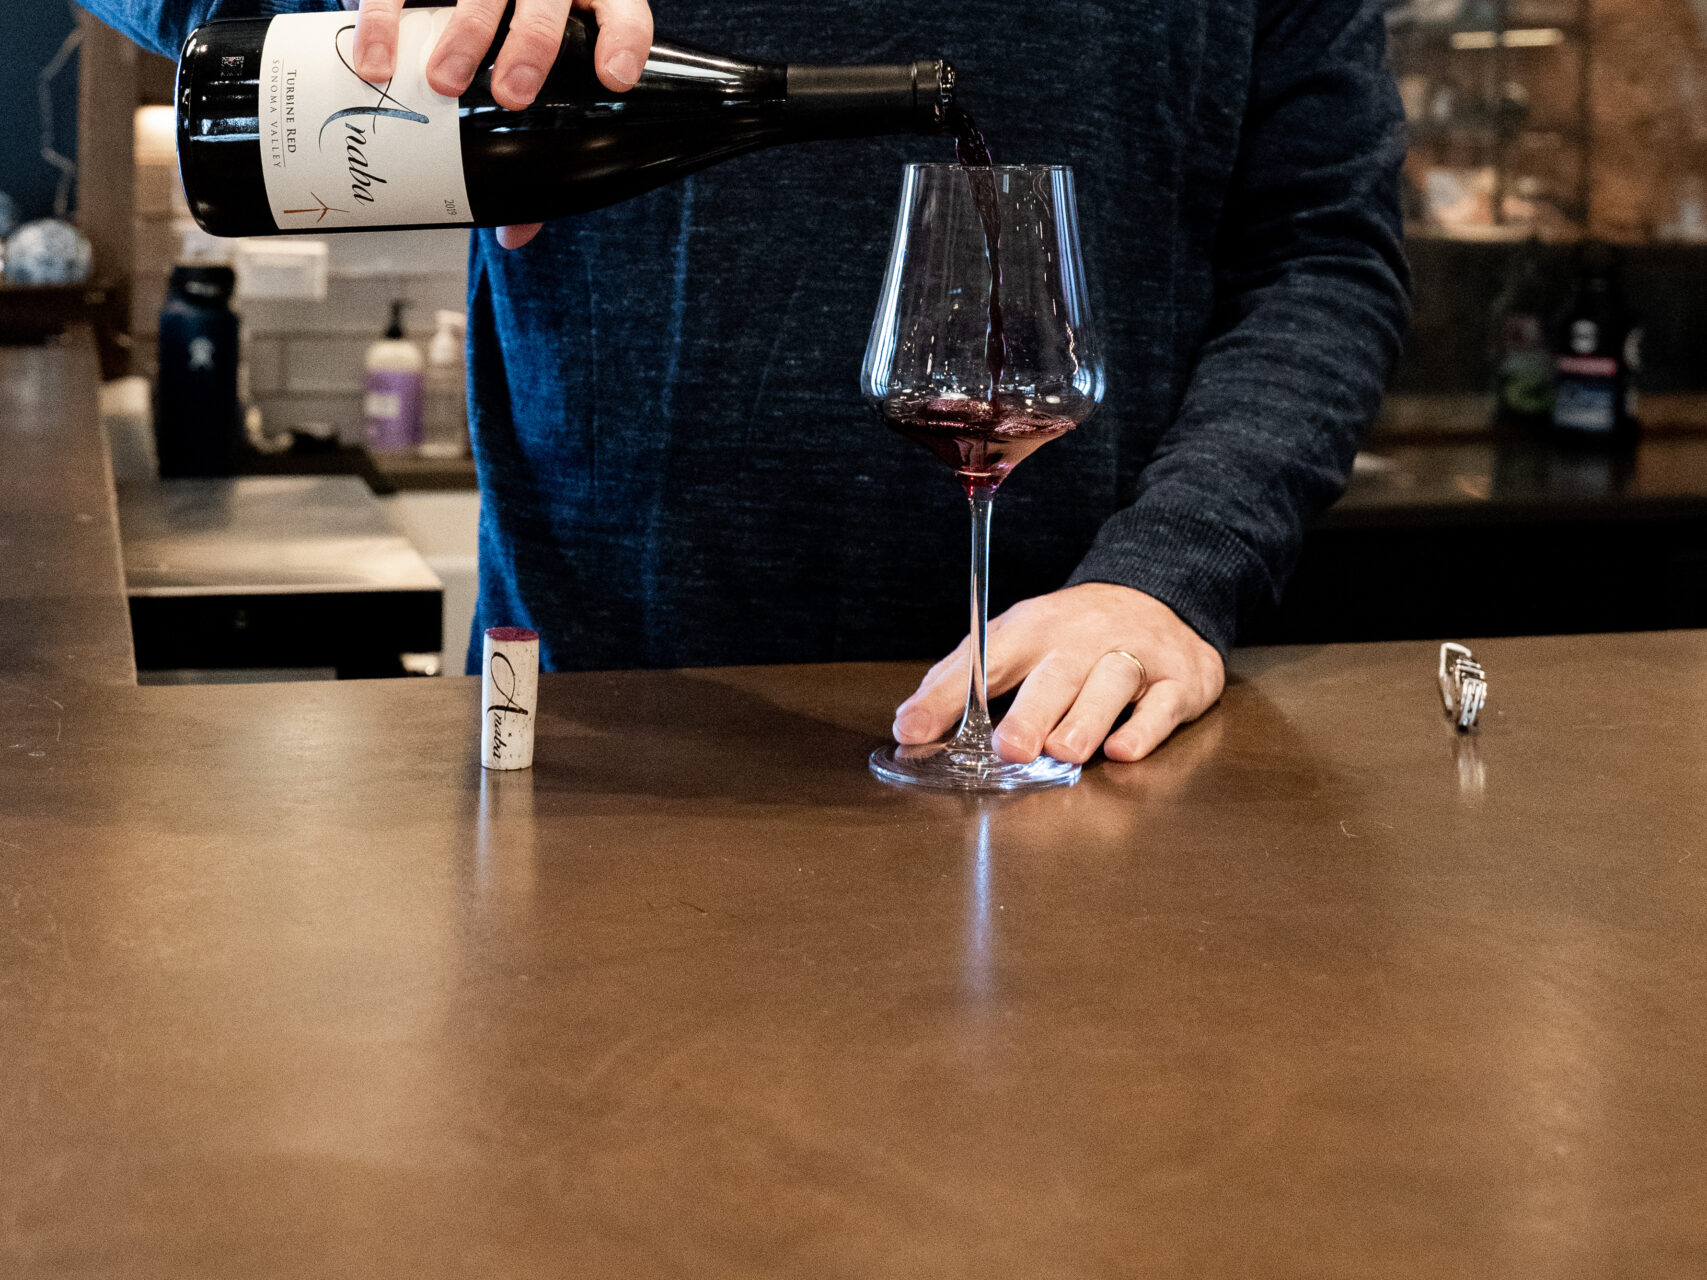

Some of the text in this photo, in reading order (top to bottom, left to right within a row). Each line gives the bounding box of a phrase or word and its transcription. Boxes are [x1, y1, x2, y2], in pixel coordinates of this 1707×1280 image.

[270, 59, 281, 168] SONOMA VALLEY
[285, 69, 297, 154] TURBINE RED
[318, 24, 430, 206] Anaba
